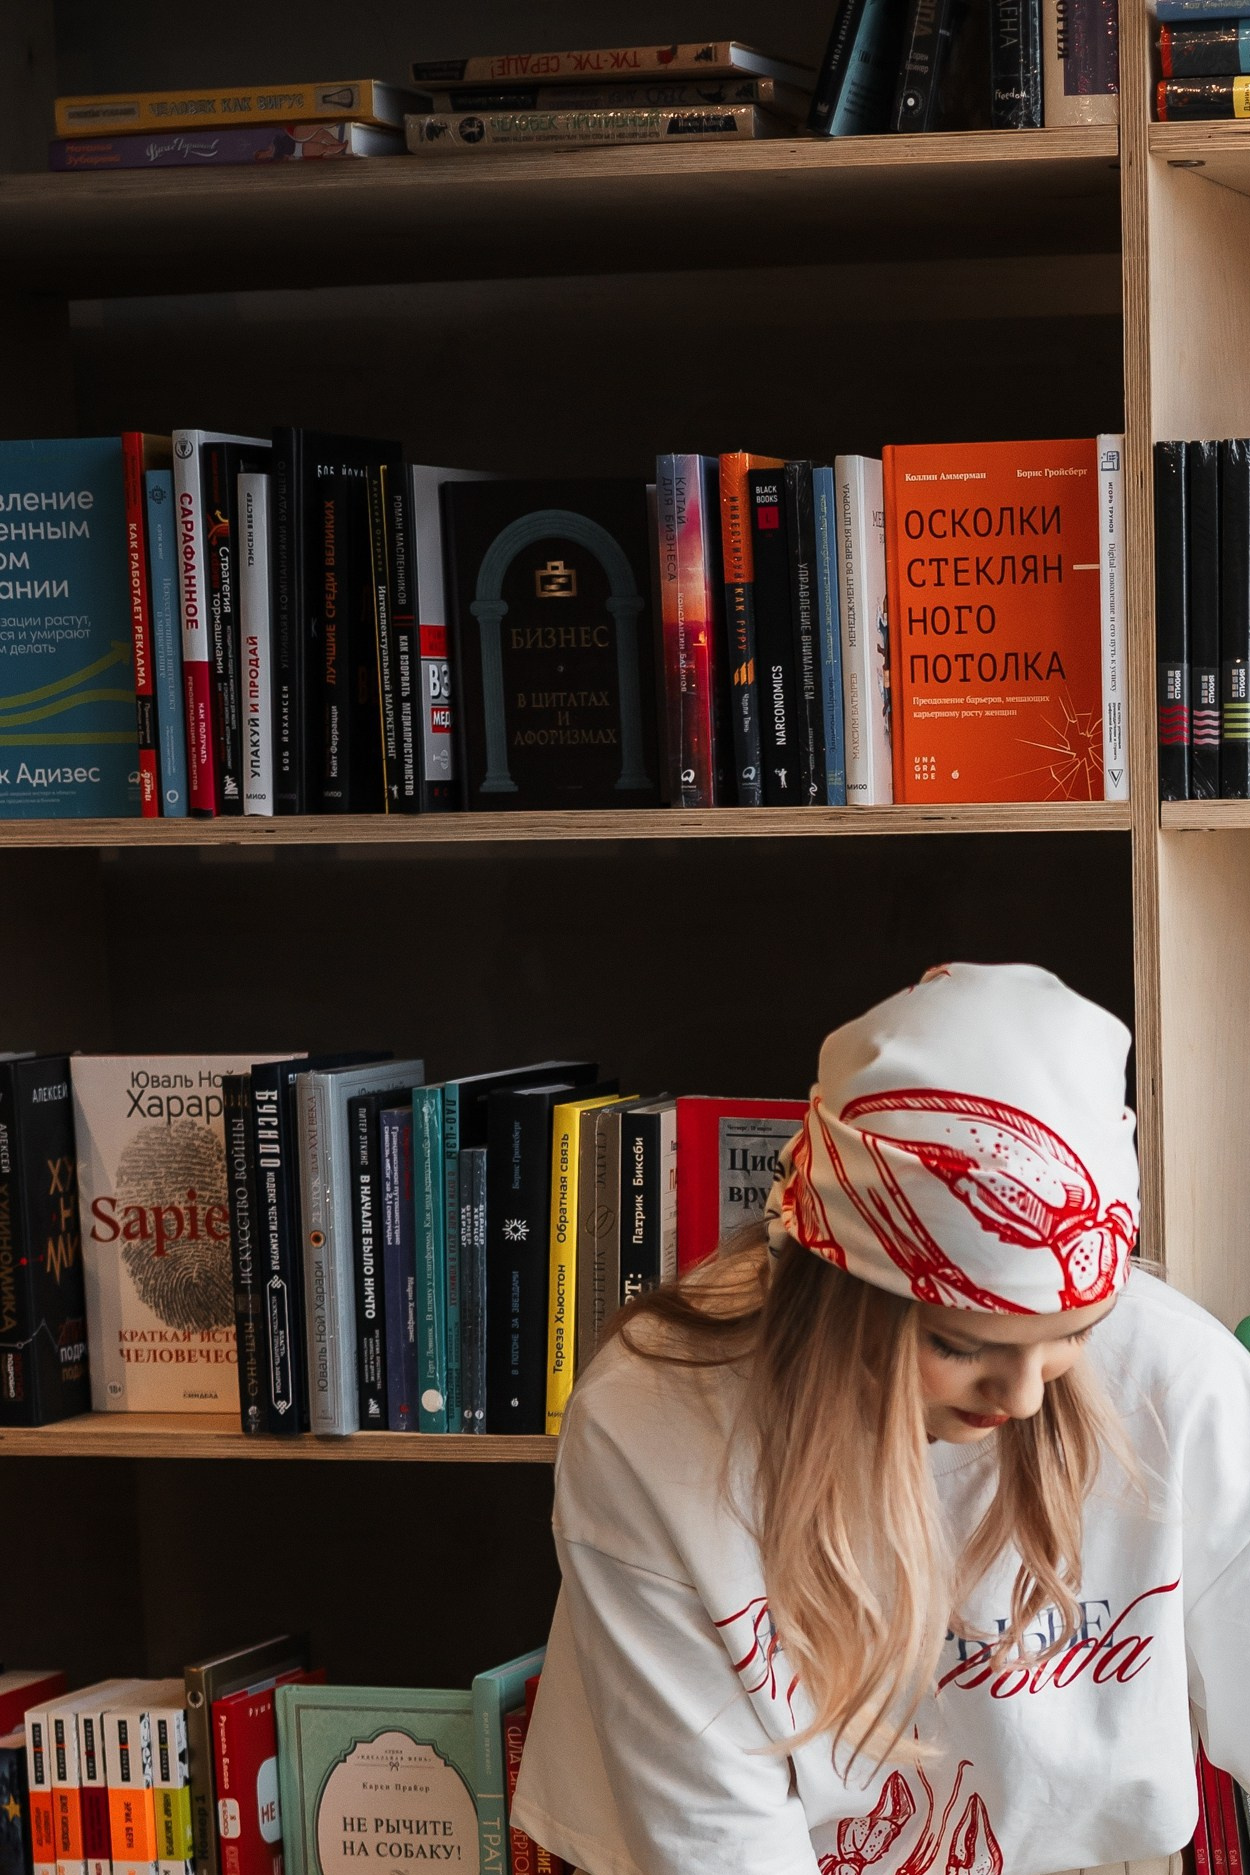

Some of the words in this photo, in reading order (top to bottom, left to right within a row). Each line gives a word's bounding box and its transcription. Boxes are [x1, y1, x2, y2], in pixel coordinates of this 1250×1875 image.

[755, 486, 777, 495] BLACK
[905, 472, 938, 482] Коллин
[939, 472, 987, 483] Аммерман
[1016, 469, 1043, 479] Борис
[1044, 467, 1088, 479] Гройсберг
[661, 476, 672, 506] ДЛЯ
[675, 476, 687, 525] КИТАЙ
[755, 494, 778, 503] BOOKS
[842, 483, 852, 531] ШТОРМА
[128, 522, 140, 550] КАК
[323, 500, 337, 566] ВЕЛИКИХ
[904, 505, 1062, 540] ОСКОЛКИ
[179, 492, 199, 630] САРАФАННОЕ
[664, 511, 678, 582] БИЗНЕСА
[843, 532, 853, 562] ВРЕМЯ
[130, 552, 143, 622] РАБОТАЕТ
[218, 546, 231, 613] Стратегия
[906, 553, 1064, 589] СТЕКЛЯН
[324, 570, 338, 619] СРЕДИ
[735, 588, 745, 612] КАК
[45, 614, 92, 628] растут,
[845, 578, 857, 648] МЕНЕДЖМЕНТ
[907, 604, 997, 637] НОГО
[10, 644, 57, 656] делать
[19, 630, 28, 640] и
[31, 628, 91, 643] умирают
[211, 593, 223, 674] тормашками
[399, 635, 408, 652] КАК
[511, 625, 610, 650] БИЗНЕС
[135, 625, 146, 688] РЕКЛАМА
[246, 636, 260, 699] ПРОДАЙ
[325, 622, 337, 687] ЛУЧШИЕ
[801, 636, 815, 700] ВНИМАНИЕМ
[909, 651, 1067, 685] ПОТОЛКА
[250, 703, 260, 713] И
[531, 691, 610, 709] ЦИТАТАХ
[771, 664, 787, 746] NARCONOMICS
[912, 696, 964, 706] Преодоление
[965, 695, 1004, 706] барьеров,
[961, 709, 983, 718] росту
[248, 717, 261, 779] УПАКУЙ
[401, 701, 415, 797] МЕДИАПРОСТРАНСТВО
[514, 728, 617, 746] АФОРИЗМАХ
[16, 762, 101, 788] Адизес
[32, 1084, 68, 1104] АЛЕКСЕЙ
[131, 1070, 194, 1089] Юваль
[358, 1107, 368, 1134] ПИТЕР
[231, 1118, 247, 1180] ВОЙНЫ
[559, 1133, 570, 1173] связь
[632, 1136, 645, 1187] Биксби
[267, 1205, 278, 1234] ЧЕСТИ
[360, 1184, 373, 1235] НАЧАЛЕ
[556, 1176, 569, 1244] Обратная
[632, 1194, 648, 1245] Патрик
[361, 1235, 375, 1276] БЫЛО
[314, 1260, 328, 1312] Харари
[363, 1278, 376, 1320] НИЧТО
[554, 1264, 566, 1324] Хьюстон
[118, 1329, 192, 1343] КРАТКАЯ
[315, 1315, 327, 1345] Ной
[552, 1328, 567, 1375] Тереза
[317, 1346, 329, 1393] Юваль
[361, 1781, 391, 1792] Карен
[394, 1782, 431, 1794] Прайор
[342, 1816, 368, 1833] НЕ
[374, 1817, 454, 1837] РЫЧИТЕ
[342, 1840, 370, 1857] НА
[376, 1841, 462, 1861] СОБАКУ!
